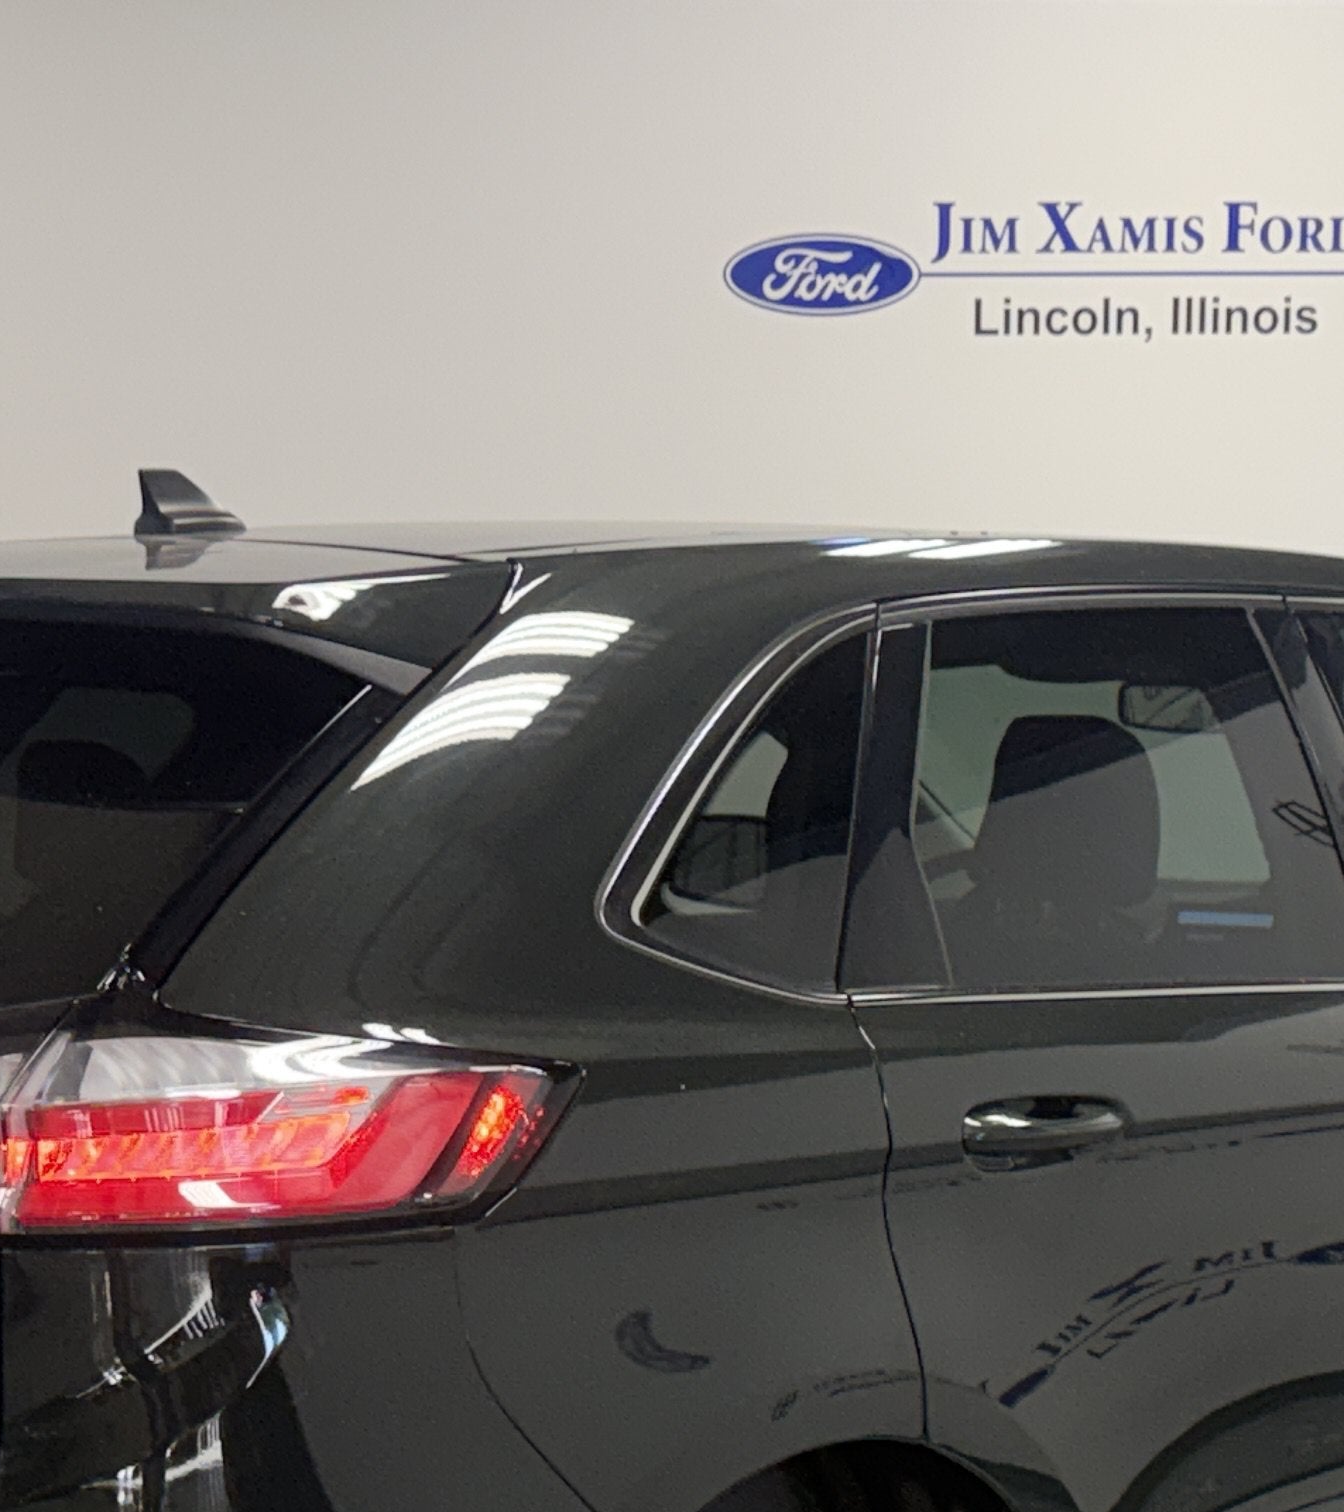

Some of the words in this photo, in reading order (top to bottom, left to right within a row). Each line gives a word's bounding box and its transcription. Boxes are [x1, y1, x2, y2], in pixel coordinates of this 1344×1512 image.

[931, 202, 1019, 264] JIM
[1036, 202, 1205, 254] XAMIS
[761, 248, 880, 304] Ford
[973, 298, 1153, 342] Lincoln,
[1170, 296, 1319, 336] Illinois
